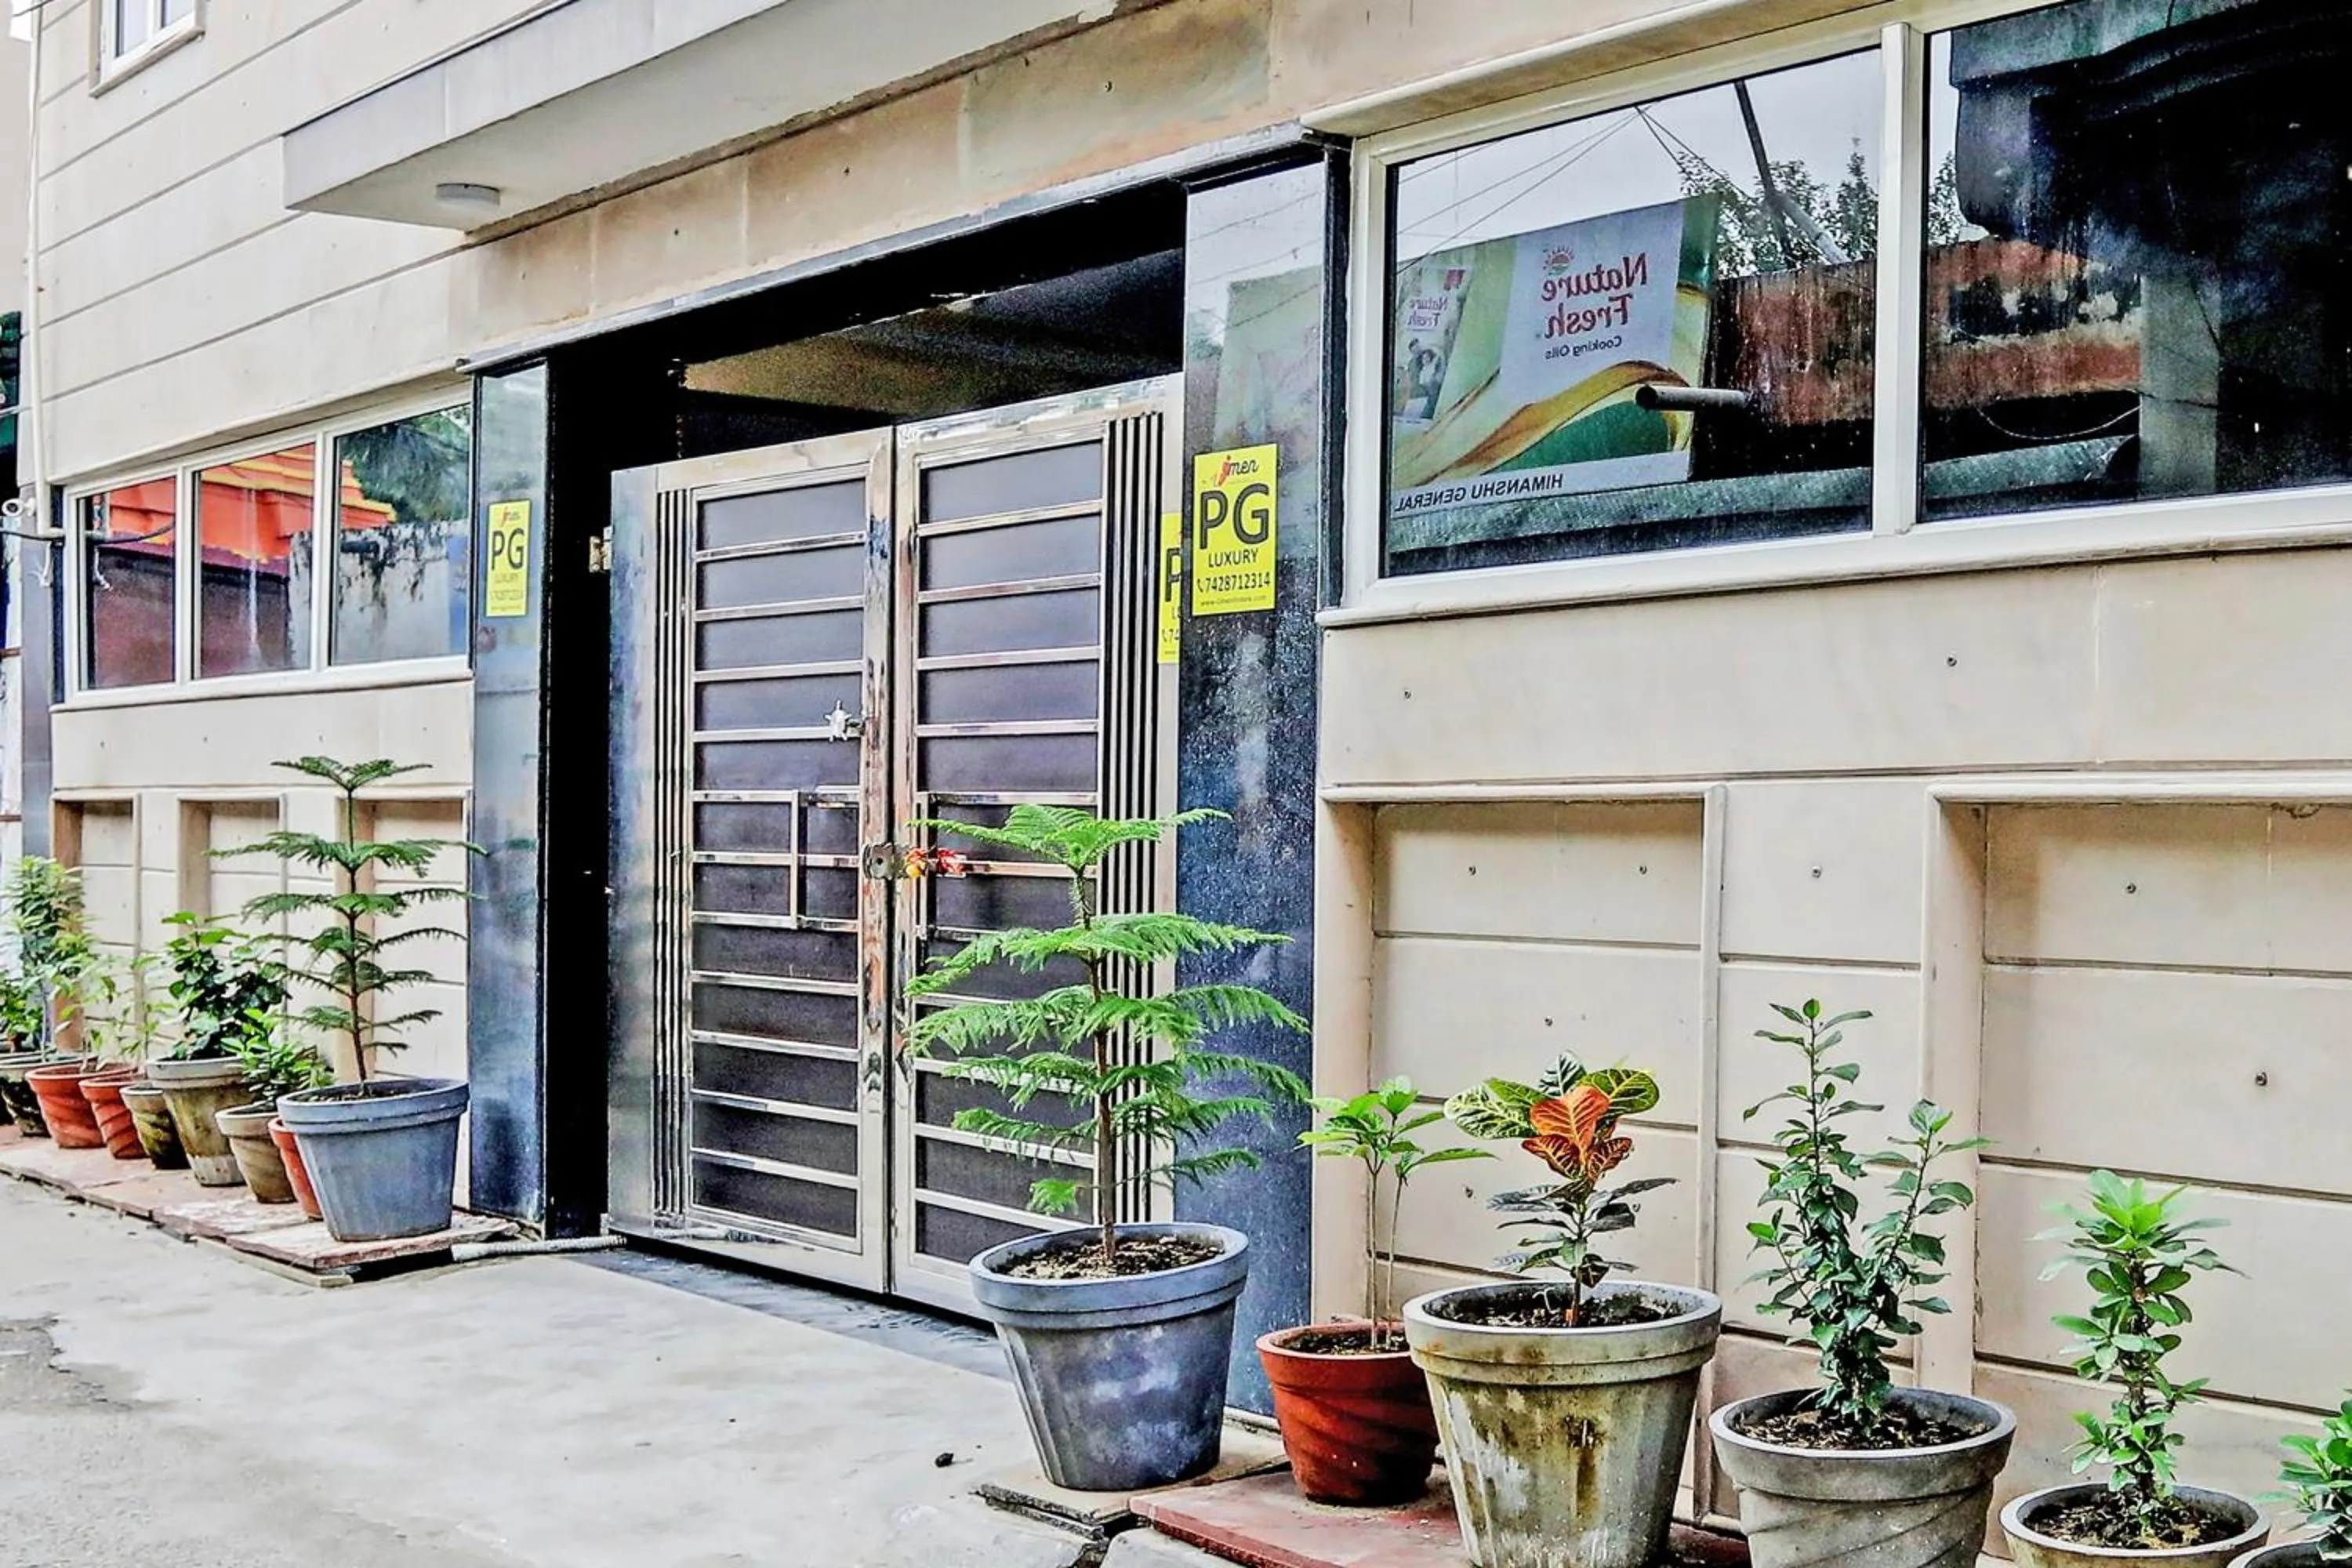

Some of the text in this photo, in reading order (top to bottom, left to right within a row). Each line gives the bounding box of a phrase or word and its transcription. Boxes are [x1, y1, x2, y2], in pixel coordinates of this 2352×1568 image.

[1199, 483, 1269, 550] PG
[492, 528, 524, 571] PG
[1208, 549, 1259, 568] LUXURY
[1205, 572, 1270, 593] 7428712314
